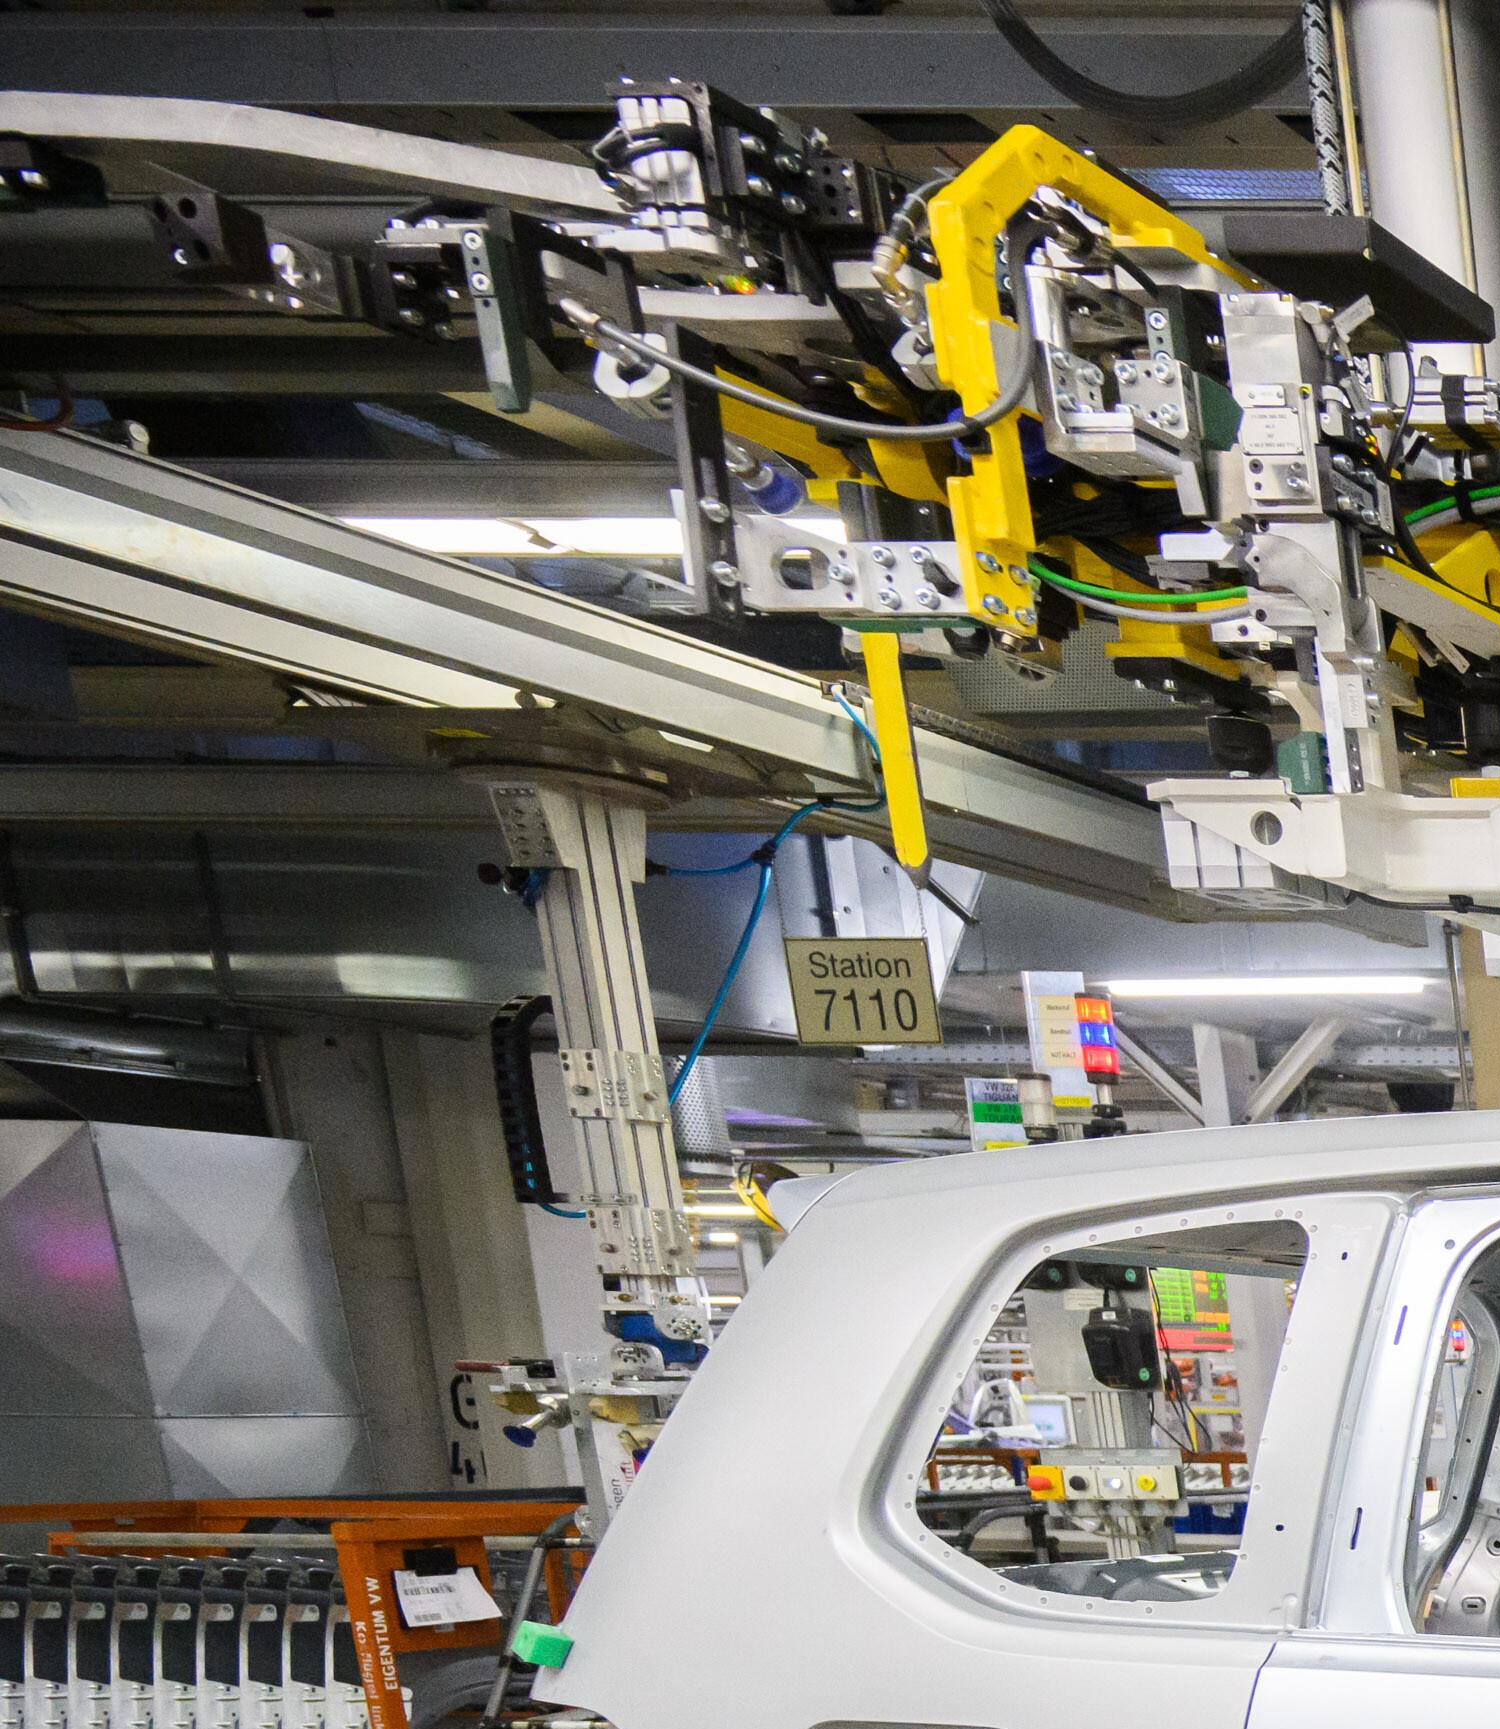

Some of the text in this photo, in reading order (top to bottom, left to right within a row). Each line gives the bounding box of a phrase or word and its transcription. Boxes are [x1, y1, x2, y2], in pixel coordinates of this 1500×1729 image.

[808, 951, 911, 978] Station
[814, 988, 918, 1031] 7110
[365, 1577, 399, 1691] EIGENTUM VW
